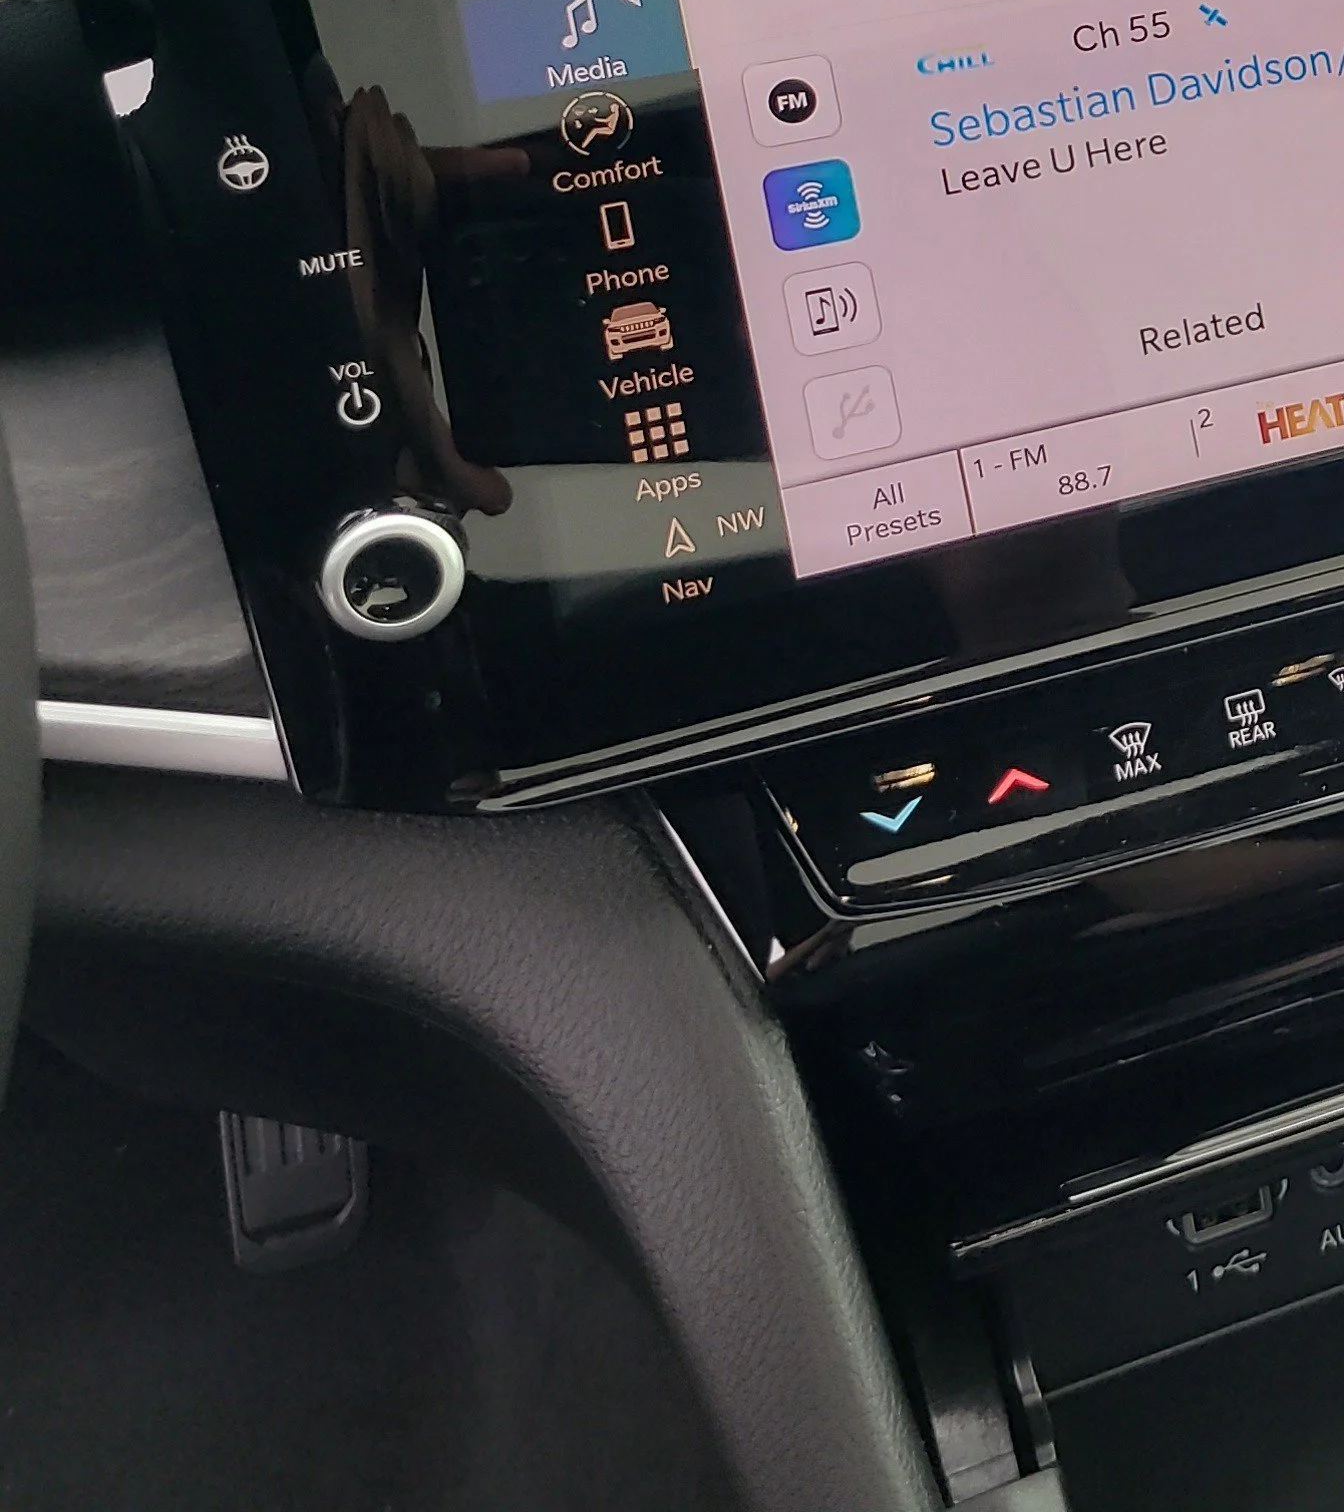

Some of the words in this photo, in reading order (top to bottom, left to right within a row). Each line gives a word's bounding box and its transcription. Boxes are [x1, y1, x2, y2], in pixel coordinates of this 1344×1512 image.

[1072, 19, 1120, 53] Ch
[1128, 10, 1173, 43] 55
[546, 56, 629, 88] Media
[775, 92, 809, 112] FM
[929, 83, 1138, 148] Sebastian
[552, 155, 664, 194] Comfort
[940, 150, 1042, 197] Leave
[1049, 143, 1076, 174] U
[1085, 128, 1169, 170] Here
[300, 249, 364, 278] MUTE
[585, 262, 671, 296] Phone
[1139, 303, 1267, 356] Related
[329, 359, 374, 382] VOL
[598, 363, 696, 400] Vehicle
[1197, 408, 1214, 431] 2
[973, 458, 985, 479] 1
[1008, 443, 1049, 472] FM
[634, 470, 703, 503] Apps
[871, 482, 906, 511] All
[1057, 464, 1113, 497] 88.7
[716, 506, 768, 538] NW
[846, 506, 943, 546] Presets
[662, 575, 713, 603] Nav
[1228, 721, 1277, 749] REAR
[1113, 752, 1162, 783] MAX
[1186, 1268, 1200, 1294] 1
